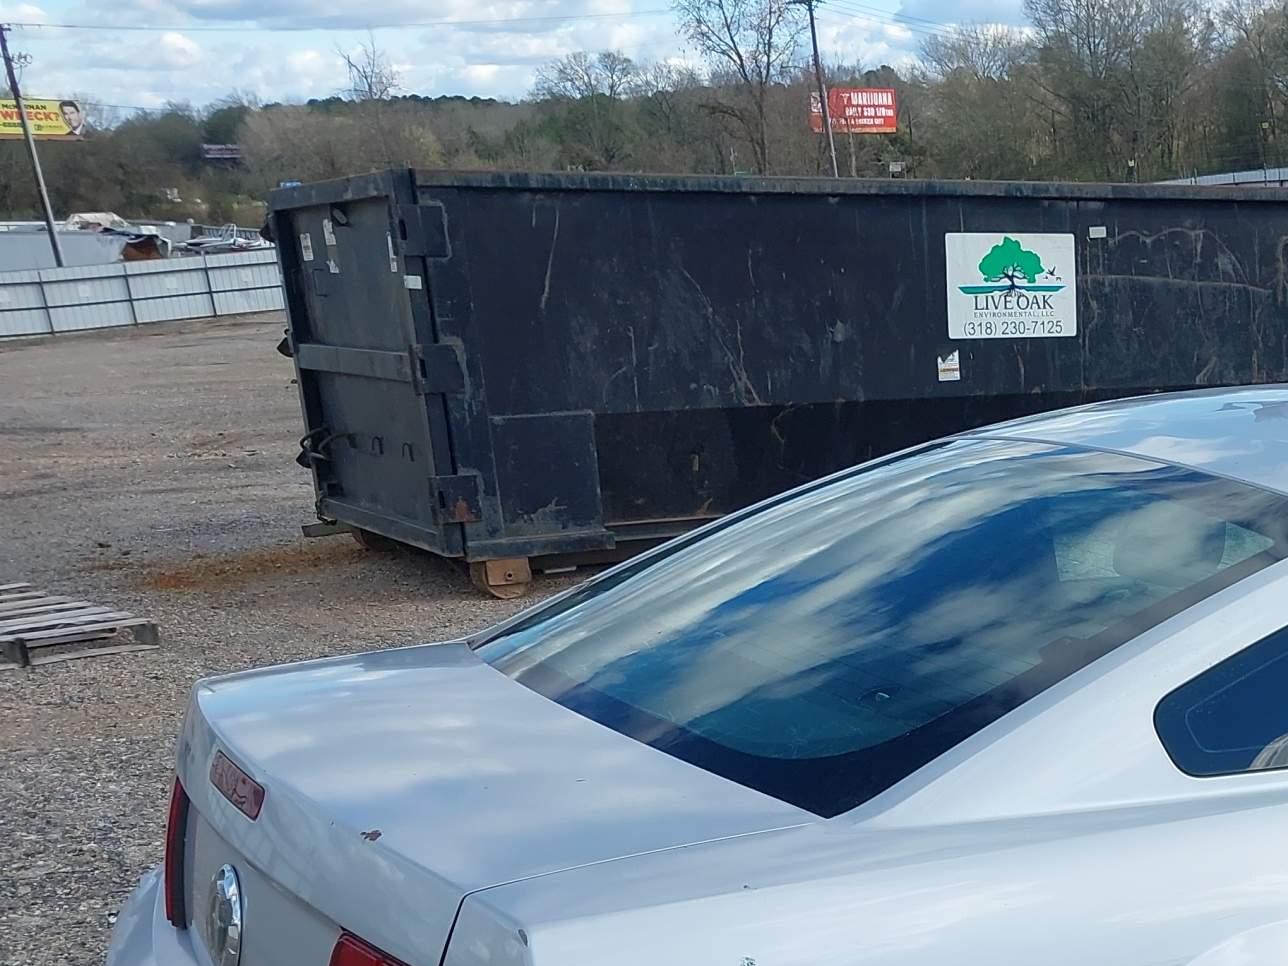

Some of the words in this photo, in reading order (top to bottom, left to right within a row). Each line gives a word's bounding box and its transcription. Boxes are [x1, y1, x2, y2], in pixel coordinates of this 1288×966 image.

[850, 92, 893, 105] MARIJUANA
[975, 294, 1013, 310] LIVE
[1017, 294, 1054, 310] OAK
[963, 321, 998, 337] (318)
[1001, 320, 1063, 336] 230-7125
